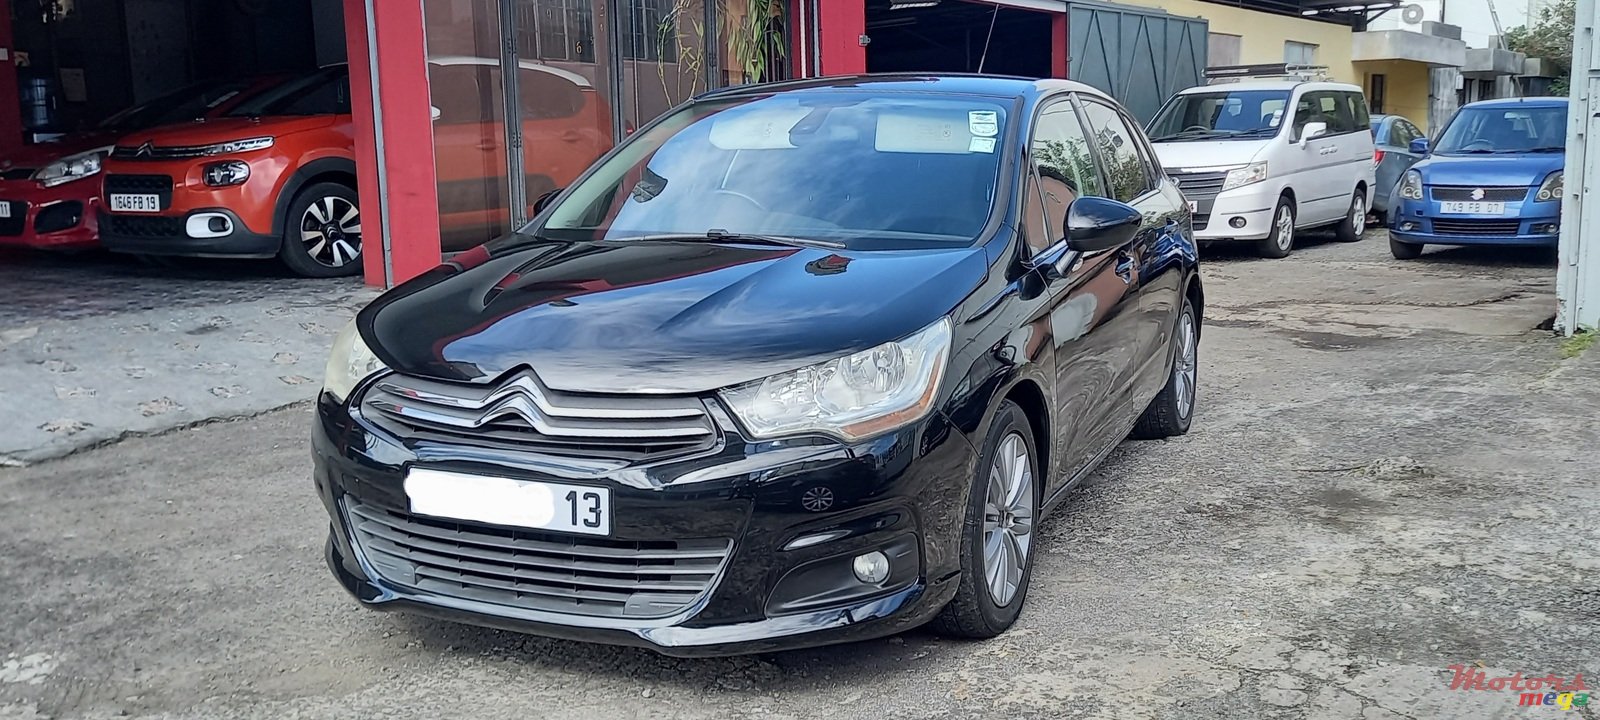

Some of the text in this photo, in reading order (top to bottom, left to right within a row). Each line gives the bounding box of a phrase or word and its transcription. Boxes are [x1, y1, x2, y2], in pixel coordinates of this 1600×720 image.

[576, 41, 582, 54] 6
[114, 196, 131, 209] 1646
[146, 196, 156, 210] 19
[1446, 202, 1463, 213] 749
[565, 490, 602, 528] 13
